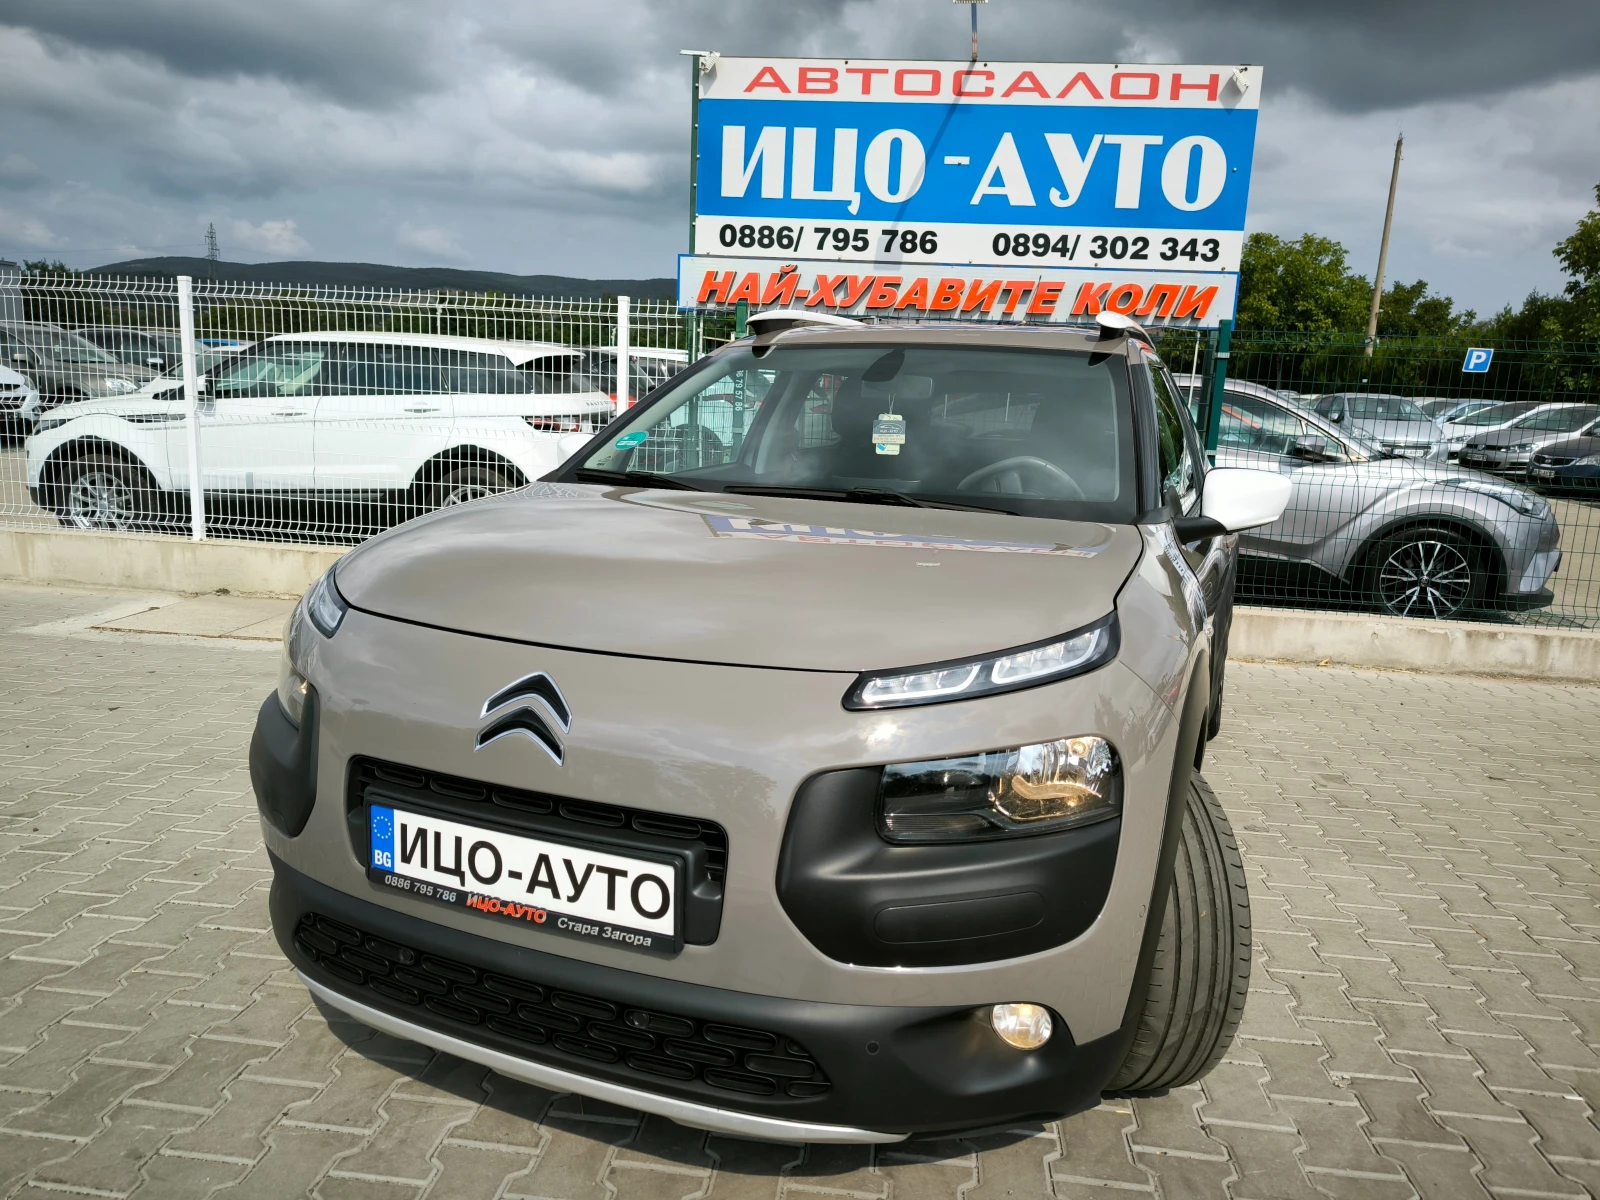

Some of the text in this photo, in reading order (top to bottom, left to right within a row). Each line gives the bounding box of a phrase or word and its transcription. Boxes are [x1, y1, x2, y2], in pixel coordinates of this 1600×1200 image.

[744, 66, 1220, 101] АВТОСАЛОН
[719, 223, 938, 255] 0886/ 795 786
[992, 232, 1220, 263] 0894/ 302 343
[696, 264, 1219, 319] НАЙ-ХУБАВИТЕ КОЛИ
[1468, 351, 1487, 370] P
[374, 849, 392, 868] BG
[400, 822, 671, 920] ИЦО-АУТО
[384, 874, 652, 947] 0886 795 786 ИЦО-АУТО Стара Загора
